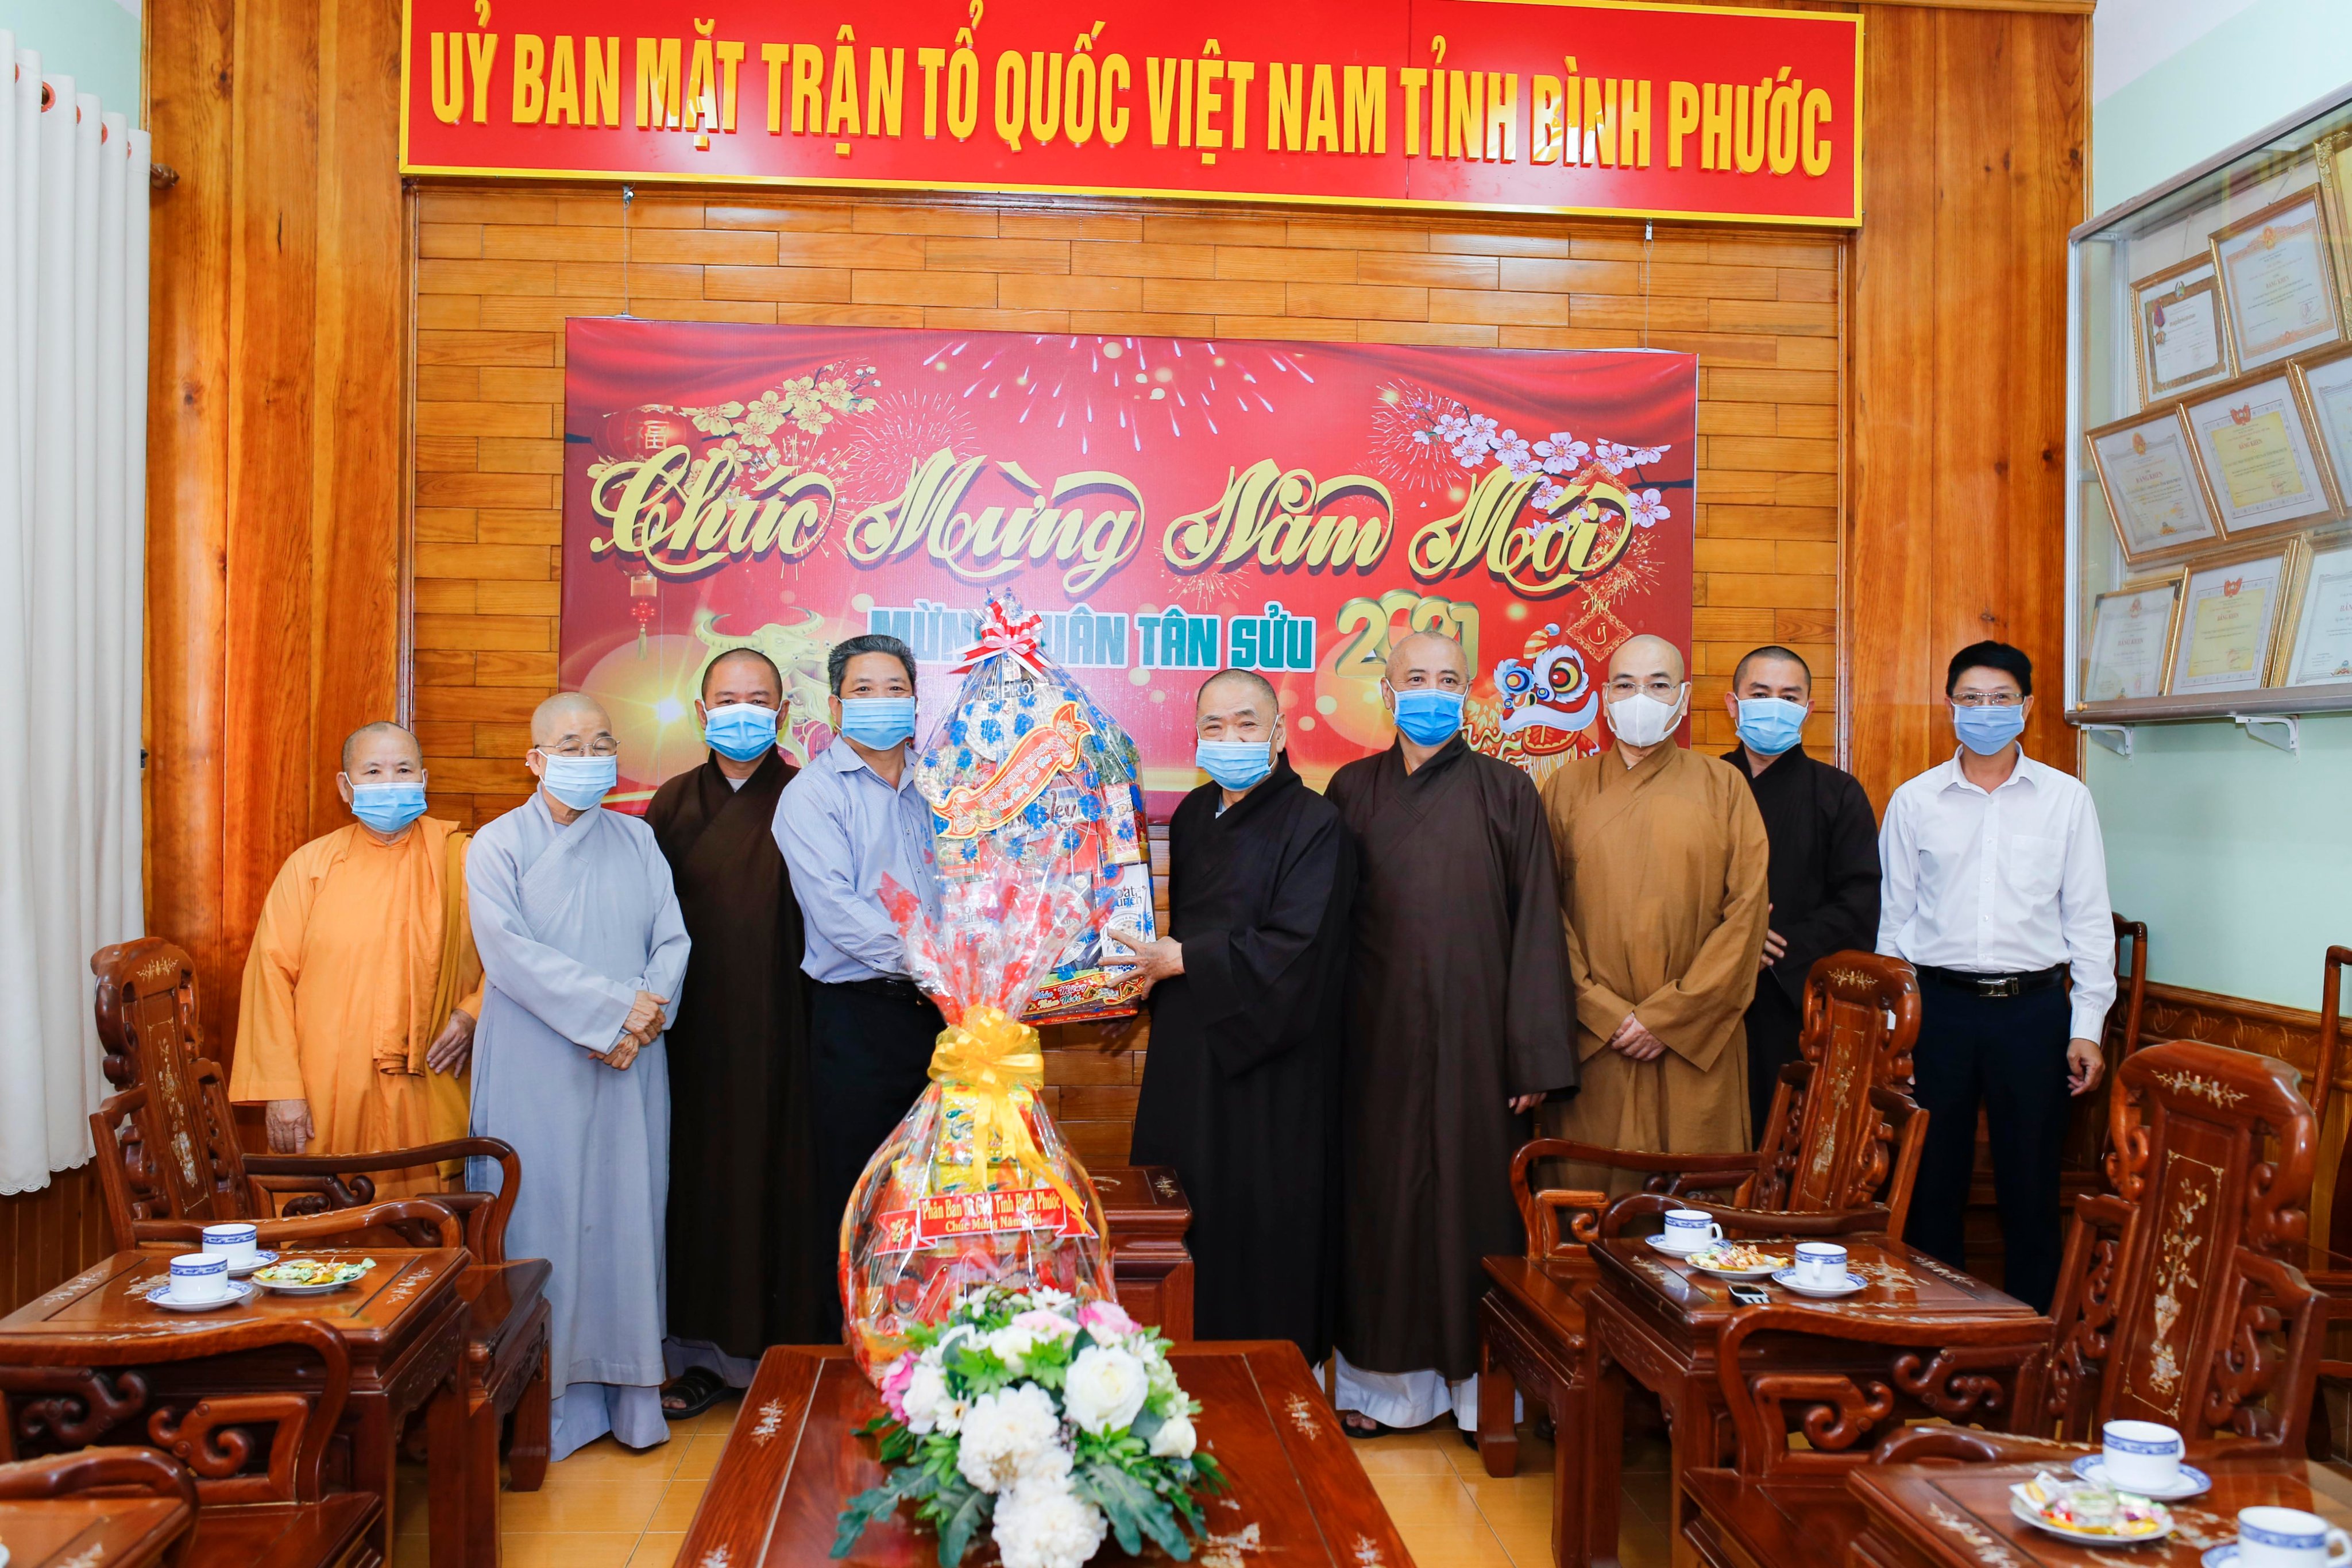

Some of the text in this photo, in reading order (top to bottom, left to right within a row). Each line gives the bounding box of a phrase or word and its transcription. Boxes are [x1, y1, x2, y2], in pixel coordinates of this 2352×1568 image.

[513, 34, 620, 128] BAN
[635, 17, 746, 150] MẶT
[761, 24, 905, 157] TRẬN
[917, 0, 983, 141] TỔ
[995, 20, 1131, 153] QUỐC
[1146, 38, 1255, 165] VIỆT
[1268, 62, 1387, 154] NAM
[1400, 34, 1518, 164] TỈNH
[1531, 56, 1652, 169] BÌNH
[1667, 65, 1832, 177] PHƯỚC
[590, 445, 1633, 594] Chúc Mừng Năm Mới
[870, 600, 981, 662] MỪN
[1038, 605, 1126, 666] UÂN
[1138, 608, 1218, 666] TÂN
[1231, 604, 1312, 669] SỬU
[982, 793, 994, 805] Ban
[1032, 983, 1087, 1001] Chúc Mừng
[1038, 994, 1082, 1009] Năm Mới
[922, 1199, 944, 1221] Phân
[945, 1199, 962, 1218] Ban
[1036, 1190, 1061, 1210] Phước
[945, 1220, 970, 1233] Chúc
[1000, 1215, 1021, 1228] Năm
